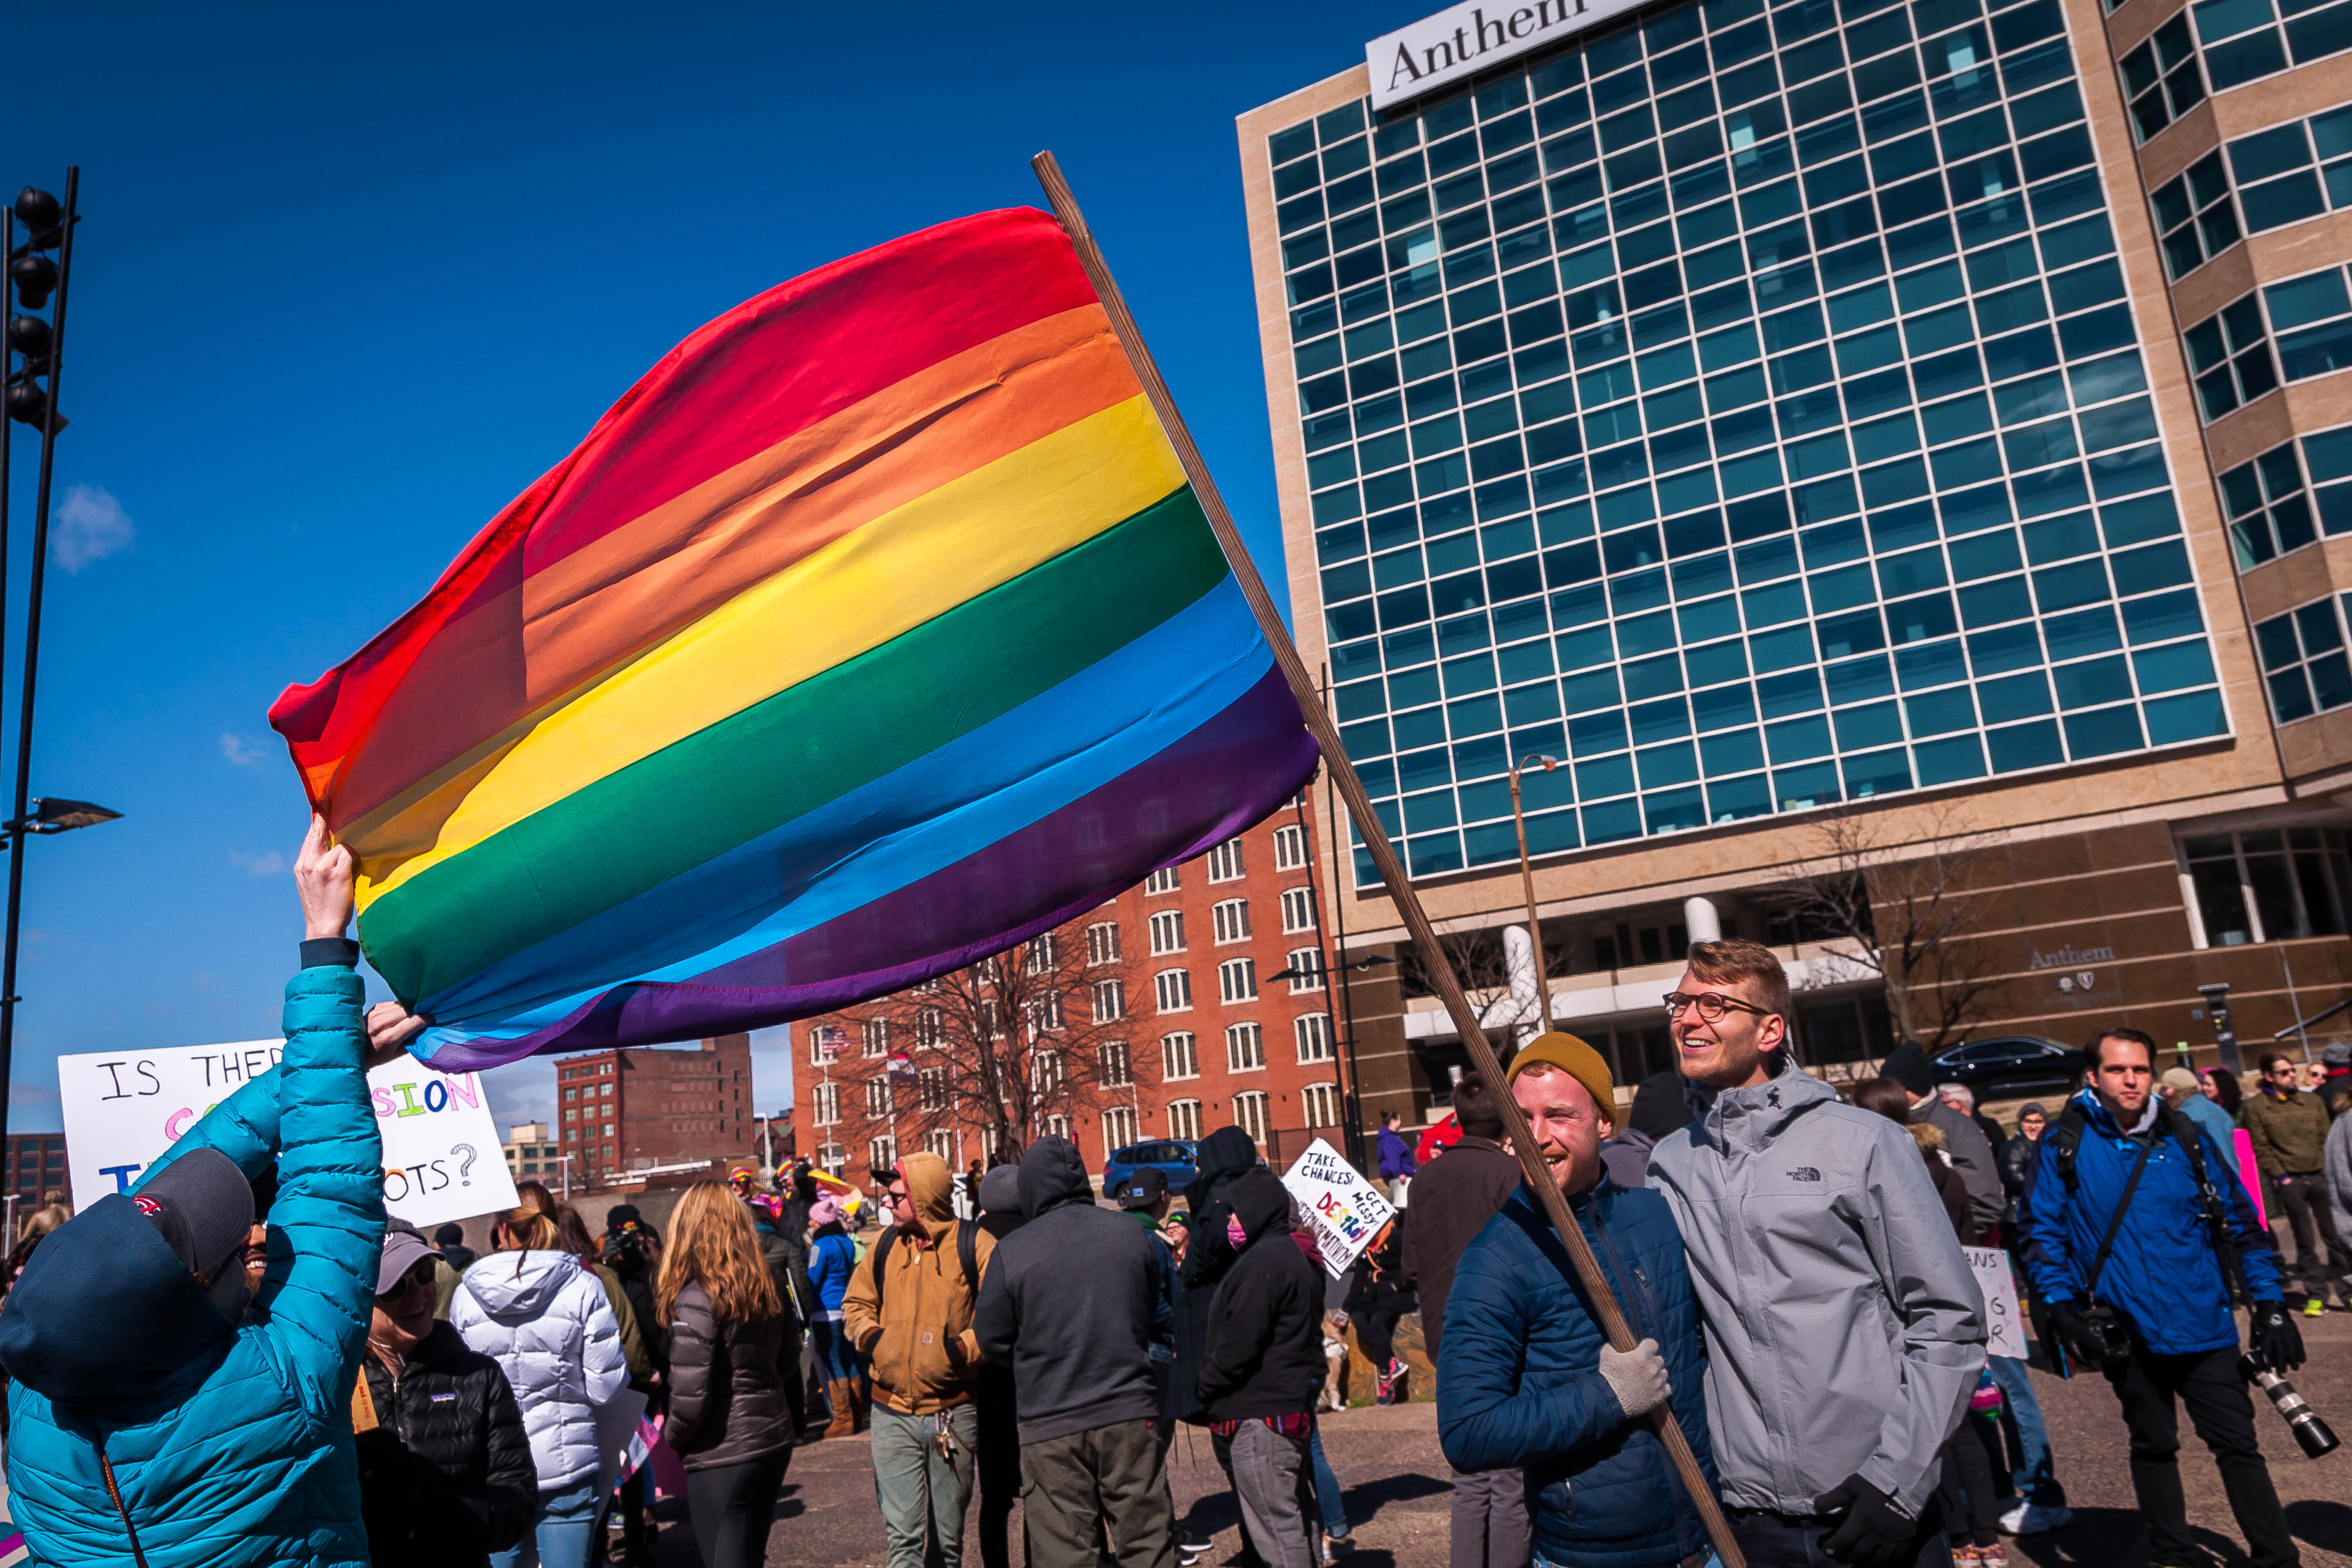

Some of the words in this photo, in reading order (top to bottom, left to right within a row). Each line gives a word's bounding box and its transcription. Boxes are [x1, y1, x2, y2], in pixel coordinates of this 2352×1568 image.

[1386, 0, 1590, 92] Anthem
[2030, 944, 2115, 970] Anthem
[96, 1060, 160, 1100] IS
[1307, 1152, 1337, 1167] TAKE
[1301, 1165, 1354, 1186] CHANCES!
[1316, 1191, 1370, 1244] DESTROY
[1352, 1191, 1380, 1228] MESSY!
[1365, 1191, 1388, 1216] GET
